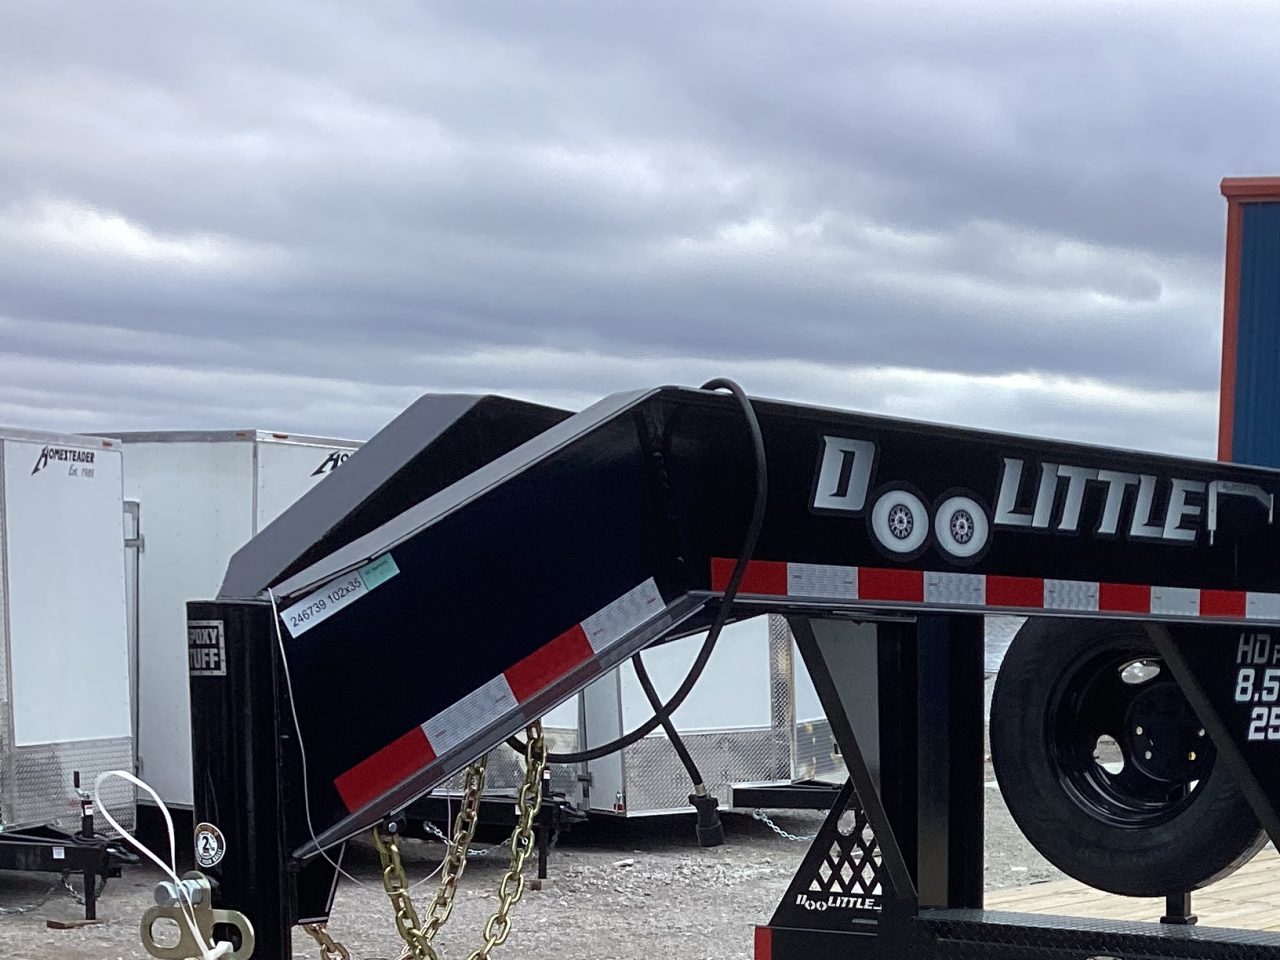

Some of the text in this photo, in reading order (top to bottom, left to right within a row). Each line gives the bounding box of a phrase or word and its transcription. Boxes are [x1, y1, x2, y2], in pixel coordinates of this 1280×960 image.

[31, 445, 95, 475] HOMESTEADER
[290, 577, 361, 628] 246739 102x35
[1237, 633, 1271, 664] HD
[1235, 668, 1280, 702] 8.5
